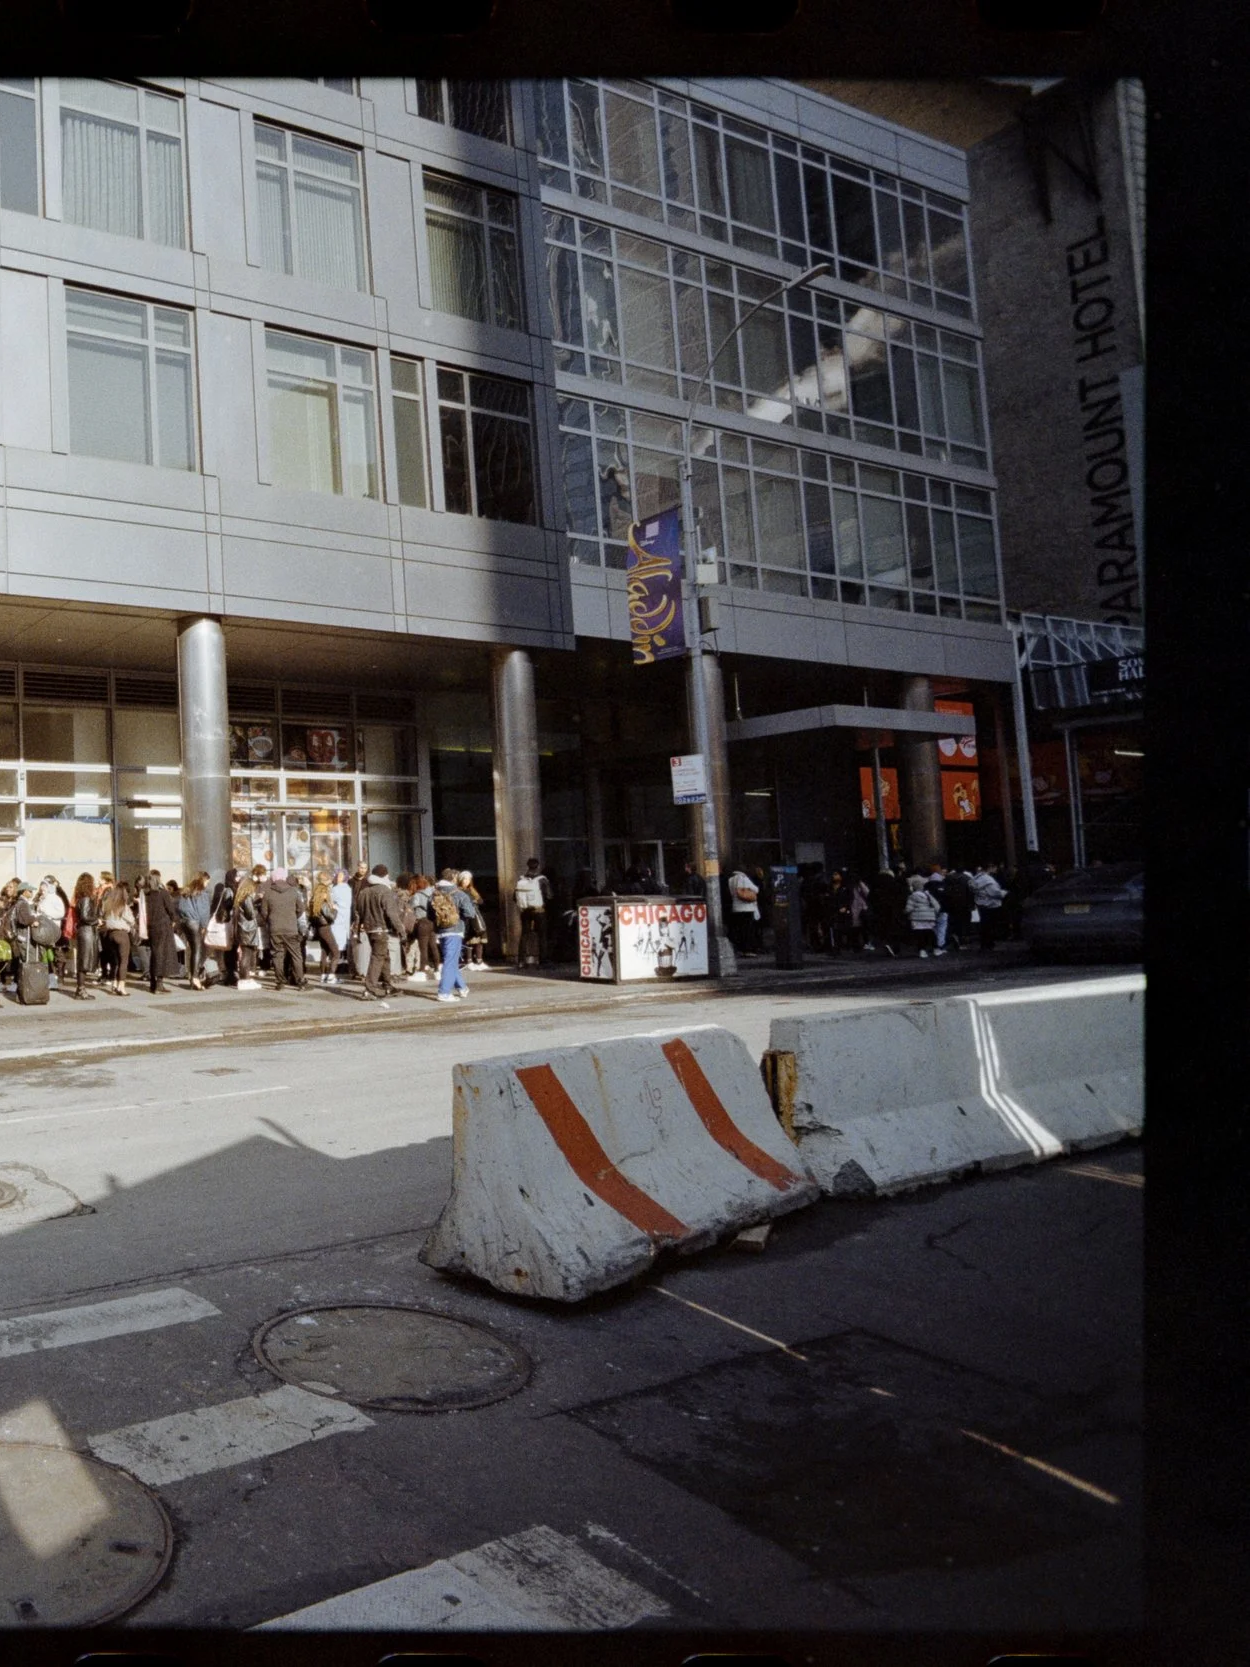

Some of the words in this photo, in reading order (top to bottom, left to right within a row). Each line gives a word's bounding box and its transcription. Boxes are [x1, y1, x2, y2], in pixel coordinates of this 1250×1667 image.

[1066, 214, 1117, 363] HOTEL
[627, 521, 675, 664] Aladdin
[580, 906, 591, 976] CHICAGO
[619, 903, 706, 925] CHICAGO
